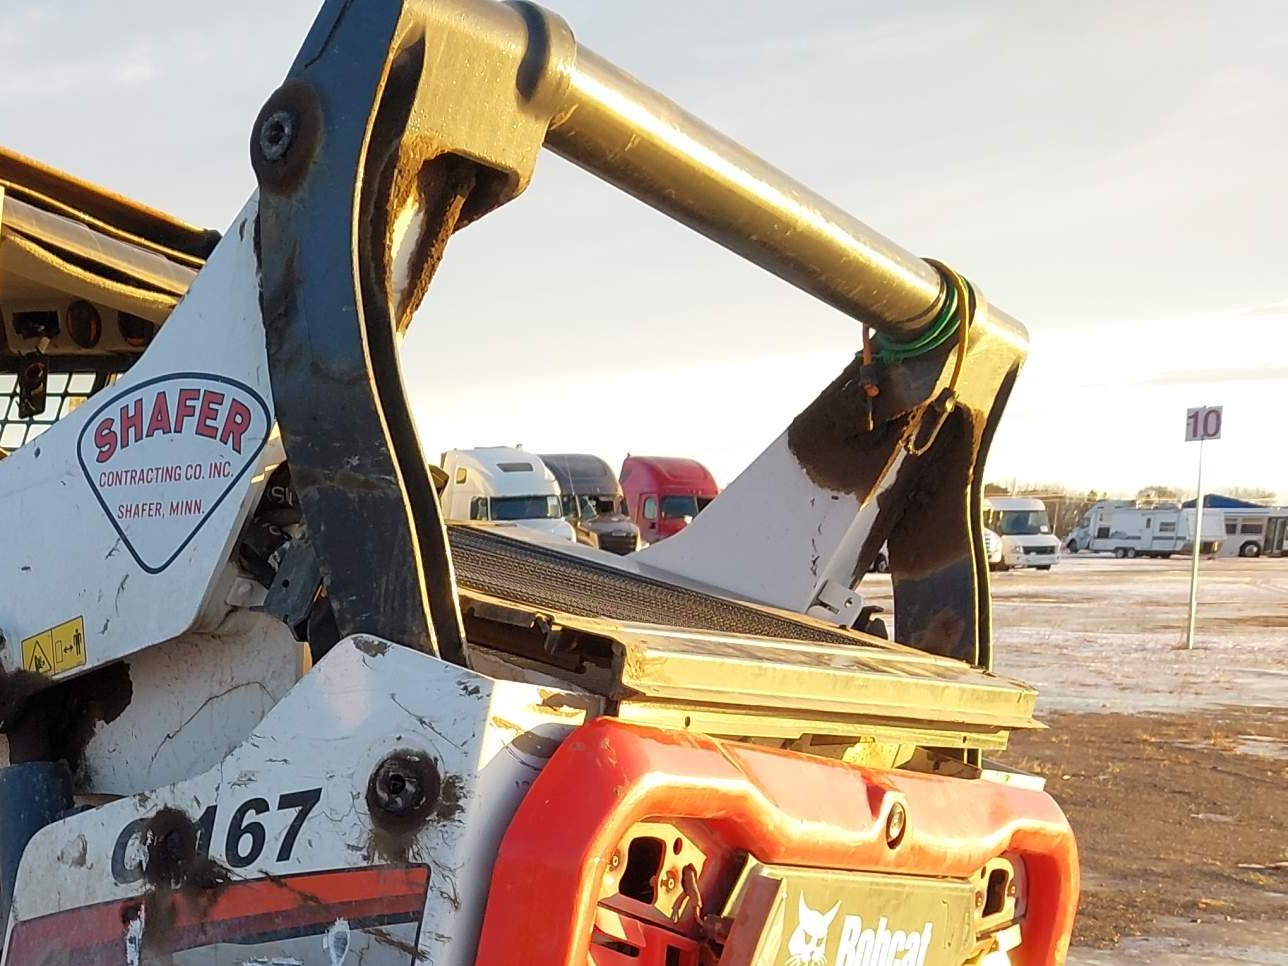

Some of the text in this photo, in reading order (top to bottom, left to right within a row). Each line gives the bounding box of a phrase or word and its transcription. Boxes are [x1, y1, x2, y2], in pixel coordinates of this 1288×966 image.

[94, 388, 252, 463] SHAFER
[1187, 409, 1222, 438] 10
[99, 461, 234, 488] CONTRACTING CO. INC.
[117, 499, 205, 519] SHAFER, MINN.
